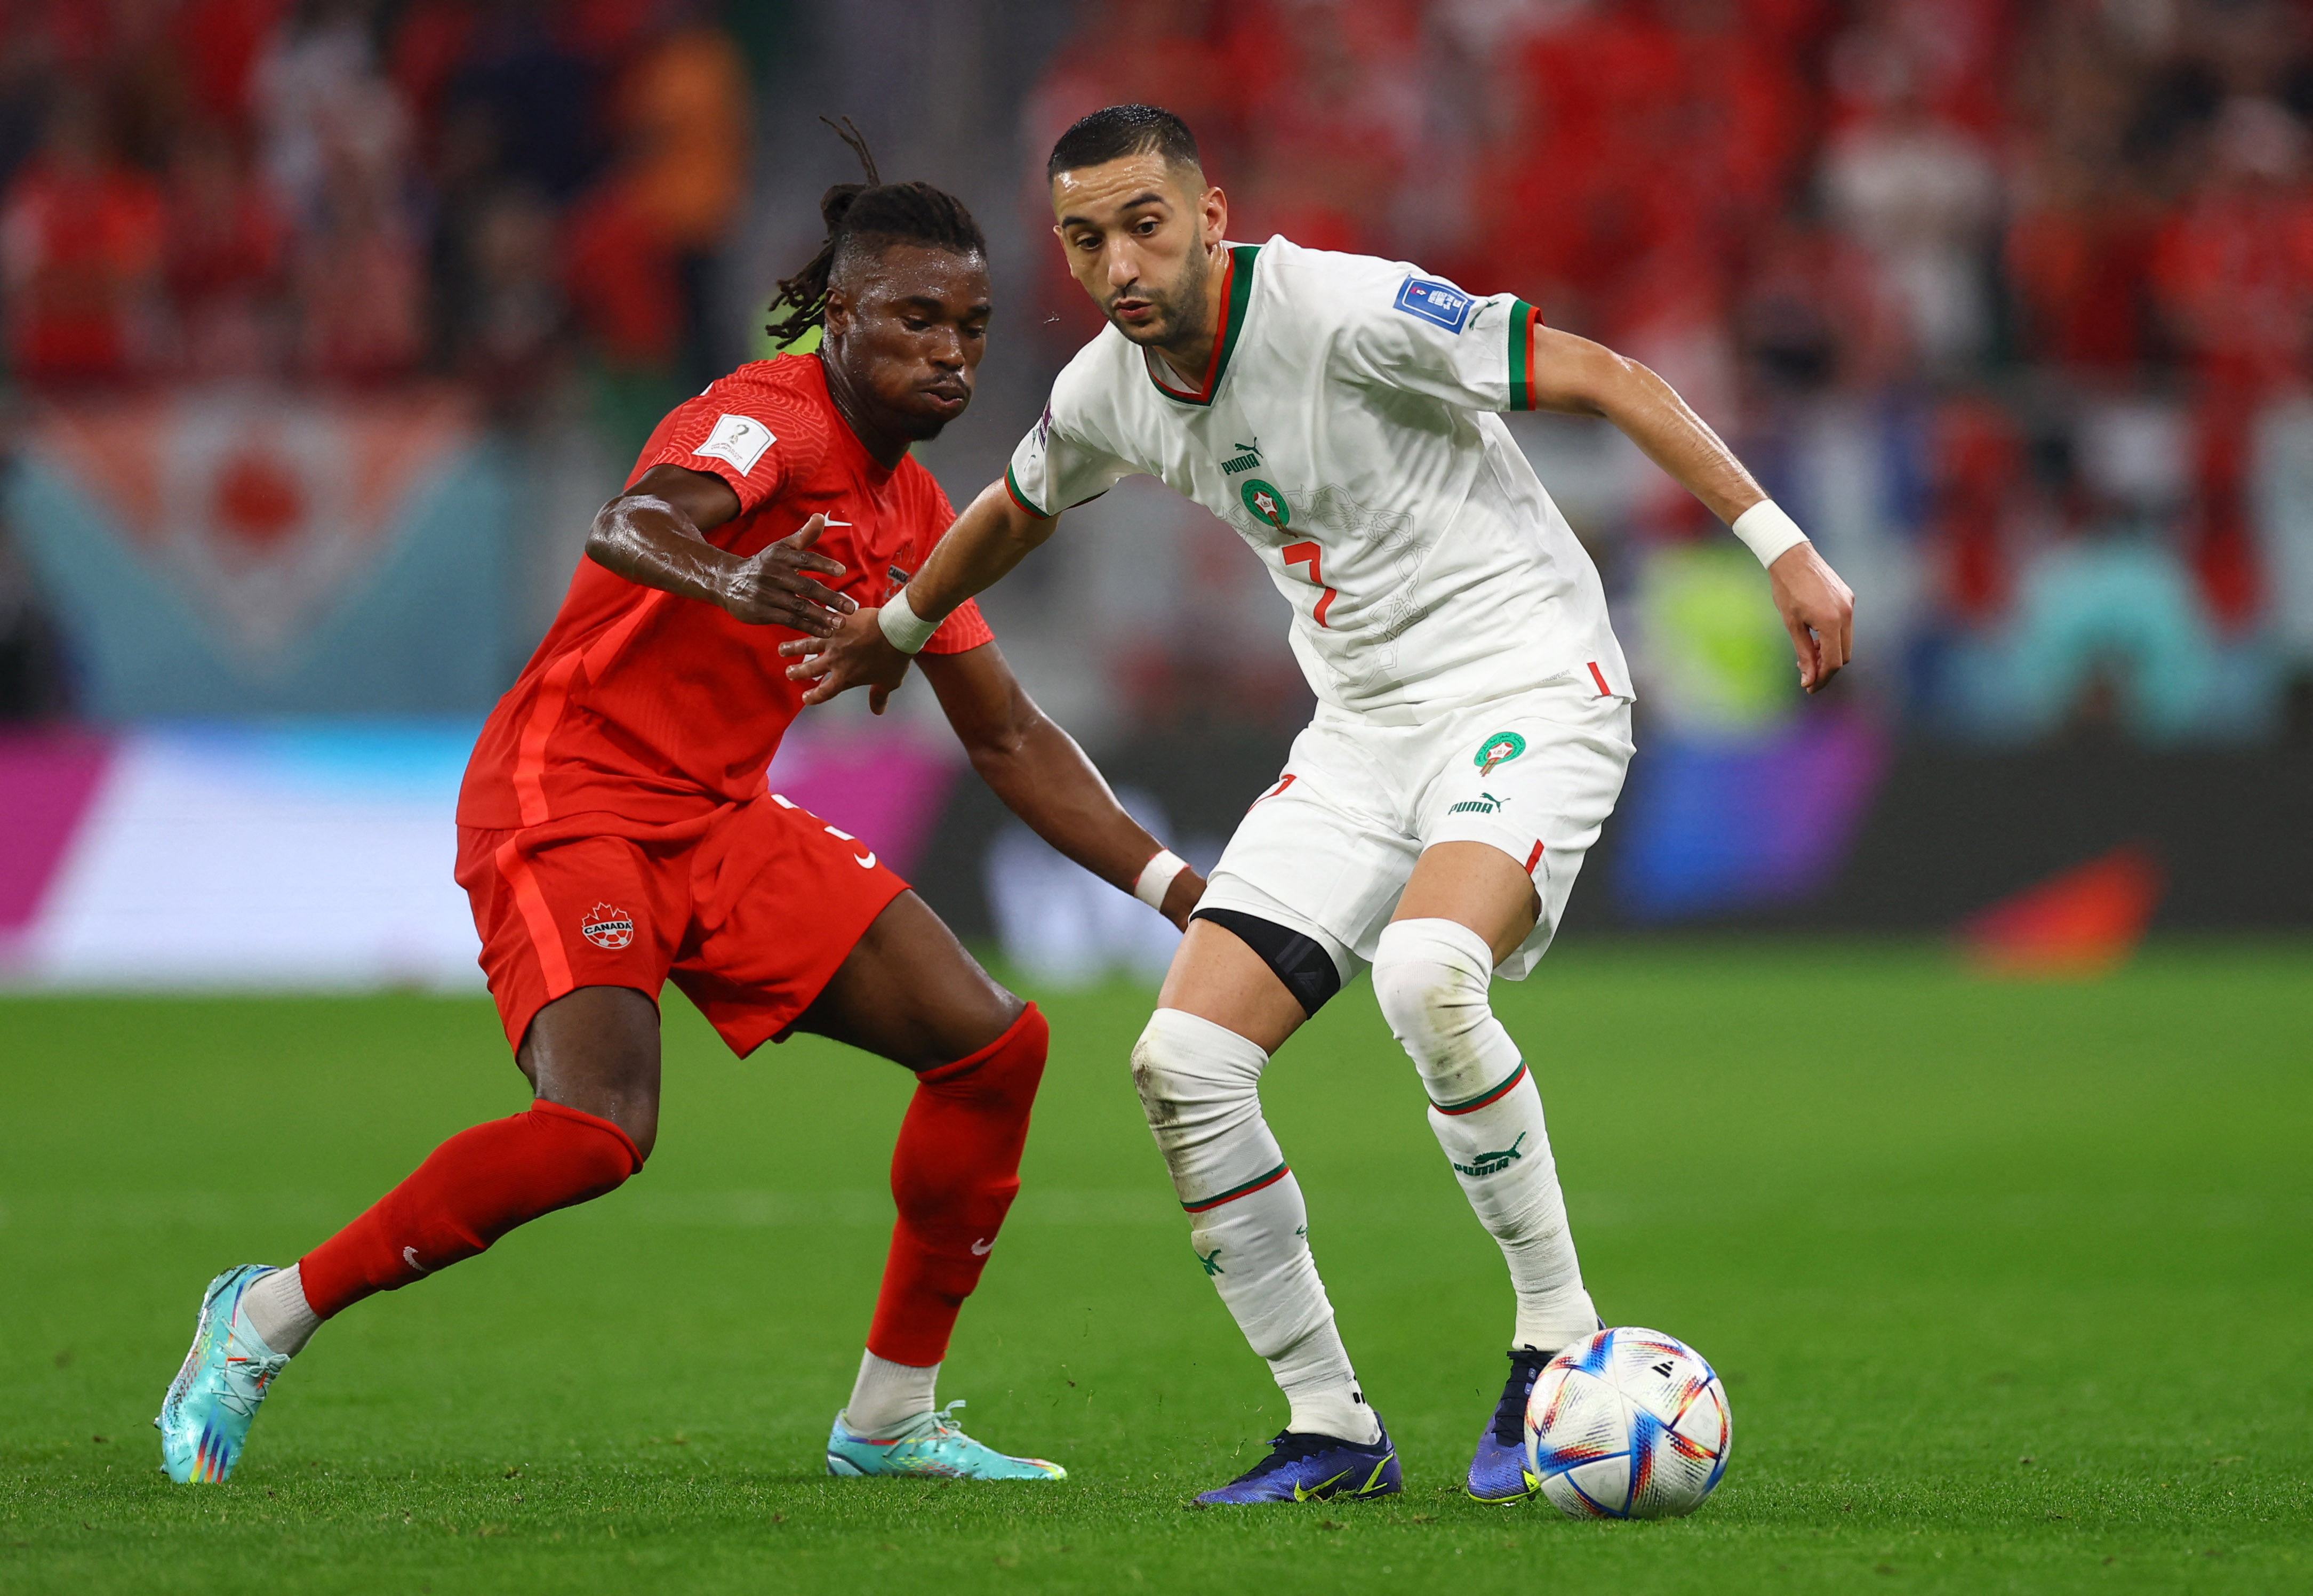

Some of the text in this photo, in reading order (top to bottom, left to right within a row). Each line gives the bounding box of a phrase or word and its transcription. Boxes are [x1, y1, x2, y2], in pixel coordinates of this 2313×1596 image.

[1221, 453, 1260, 475] PUMA
[888, 566, 909, 583] CANAD
[1282, 541, 1337, 628] 7
[1536, 669, 1571, 683] TRAWEAVE
[1447, 801, 1493, 815] PUMA
[584, 923, 633, 934] CANADA
[1453, 1157, 1509, 1176] PUMA
